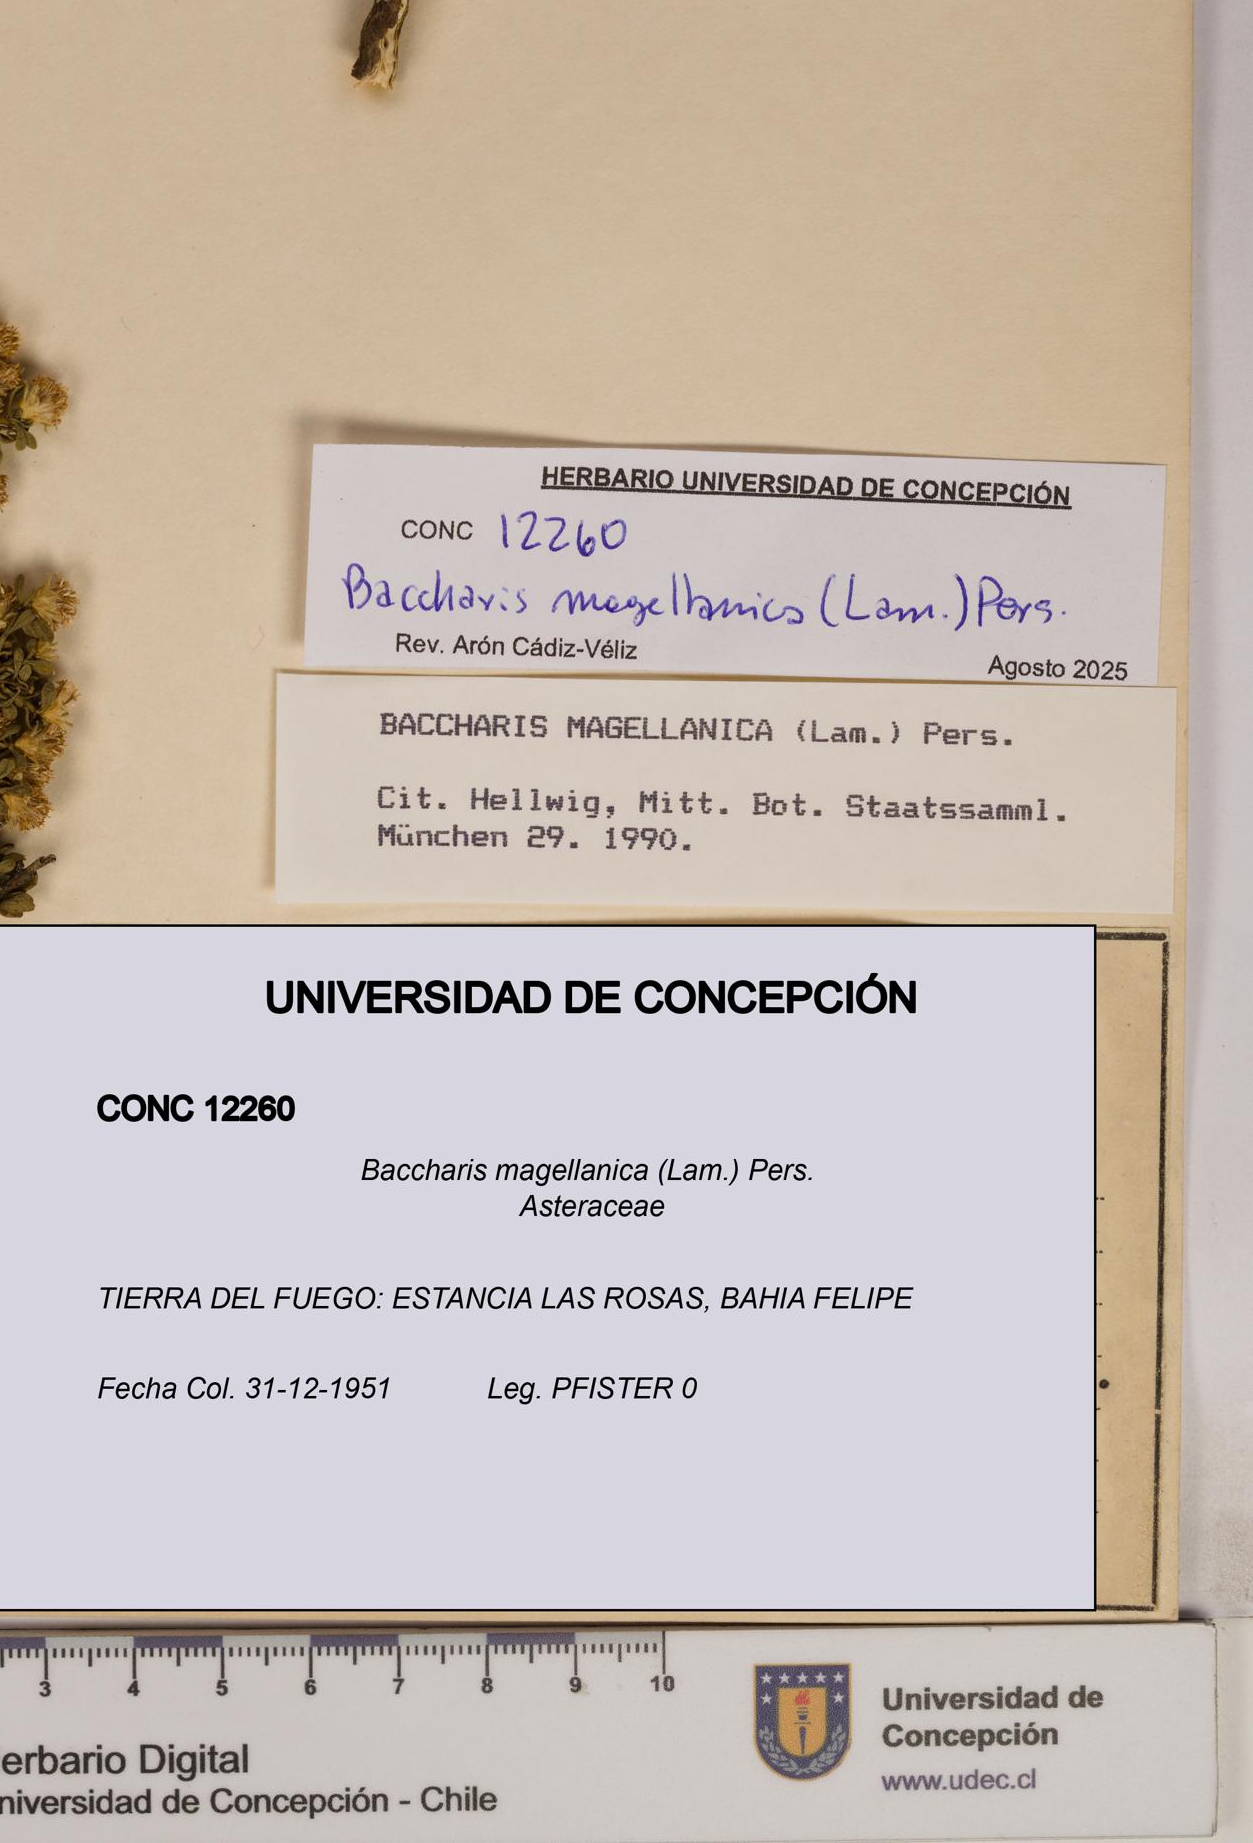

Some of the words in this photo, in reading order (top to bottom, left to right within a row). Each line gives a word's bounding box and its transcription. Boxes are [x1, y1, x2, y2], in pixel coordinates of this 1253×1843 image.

[539, 463, 677, 491] HERBARIO
[680, 468, 856, 497] UNIVERSIDAD
[858, 475, 896, 498] DE
[898, 475, 1073, 506] CONCEPCIÓN
[401, 519, 473, 541] CONC
[500, 510, 627, 558] 12260
[395, 632, 444, 654] Rev.
[452, 634, 505, 656] Arón
[512, 636, 638, 660] Cádiz-Véliz
[987, 654, 1066, 681] Agosto
[1072, 658, 1128, 682] 2025
[379, 712, 548, 738] BACCHARIS
[567, 715, 773, 742] MAGELLANICA
[796, 719, 900, 744] (Lam.)
[923, 721, 1013, 746] Pers.
[377, 785, 447, 810] Cit.
[470, 787, 615, 819] Hellwig,
[638, 790, 728, 815] Mitt.
[752, 791, 822, 817] Bot.
[845, 794, 1066, 822] Staatssamml.
[377, 823, 508, 848] München
[527, 825, 579, 849] 29.
[605, 826, 691, 852] 1990.
[39, 1680, 52, 1698] 3
[127, 1680, 141, 1697] 4
[215, 1679, 229, 1697] 5
[304, 1678, 317, 1696] 6
[392, 1678, 405, 1695] 7
[481, 1676, 494, 1694] 8
[569, 1676, 582, 1694] 9
[651, 1675, 675, 1693] 10
[882, 1684, 1059, 1712] Universidad
[1067, 1684, 1104, 1709] de
[881, 1721, 1059, 1752] Concepción
[139, 1743, 249, 1782] Digital
[881, 1767, 1036, 1791] www.udec.cl
[161, 1788, 200, 1815] de
[209, 1786, 389, 1820] Concepción
[420, 1785, 498, 1813] Chile
